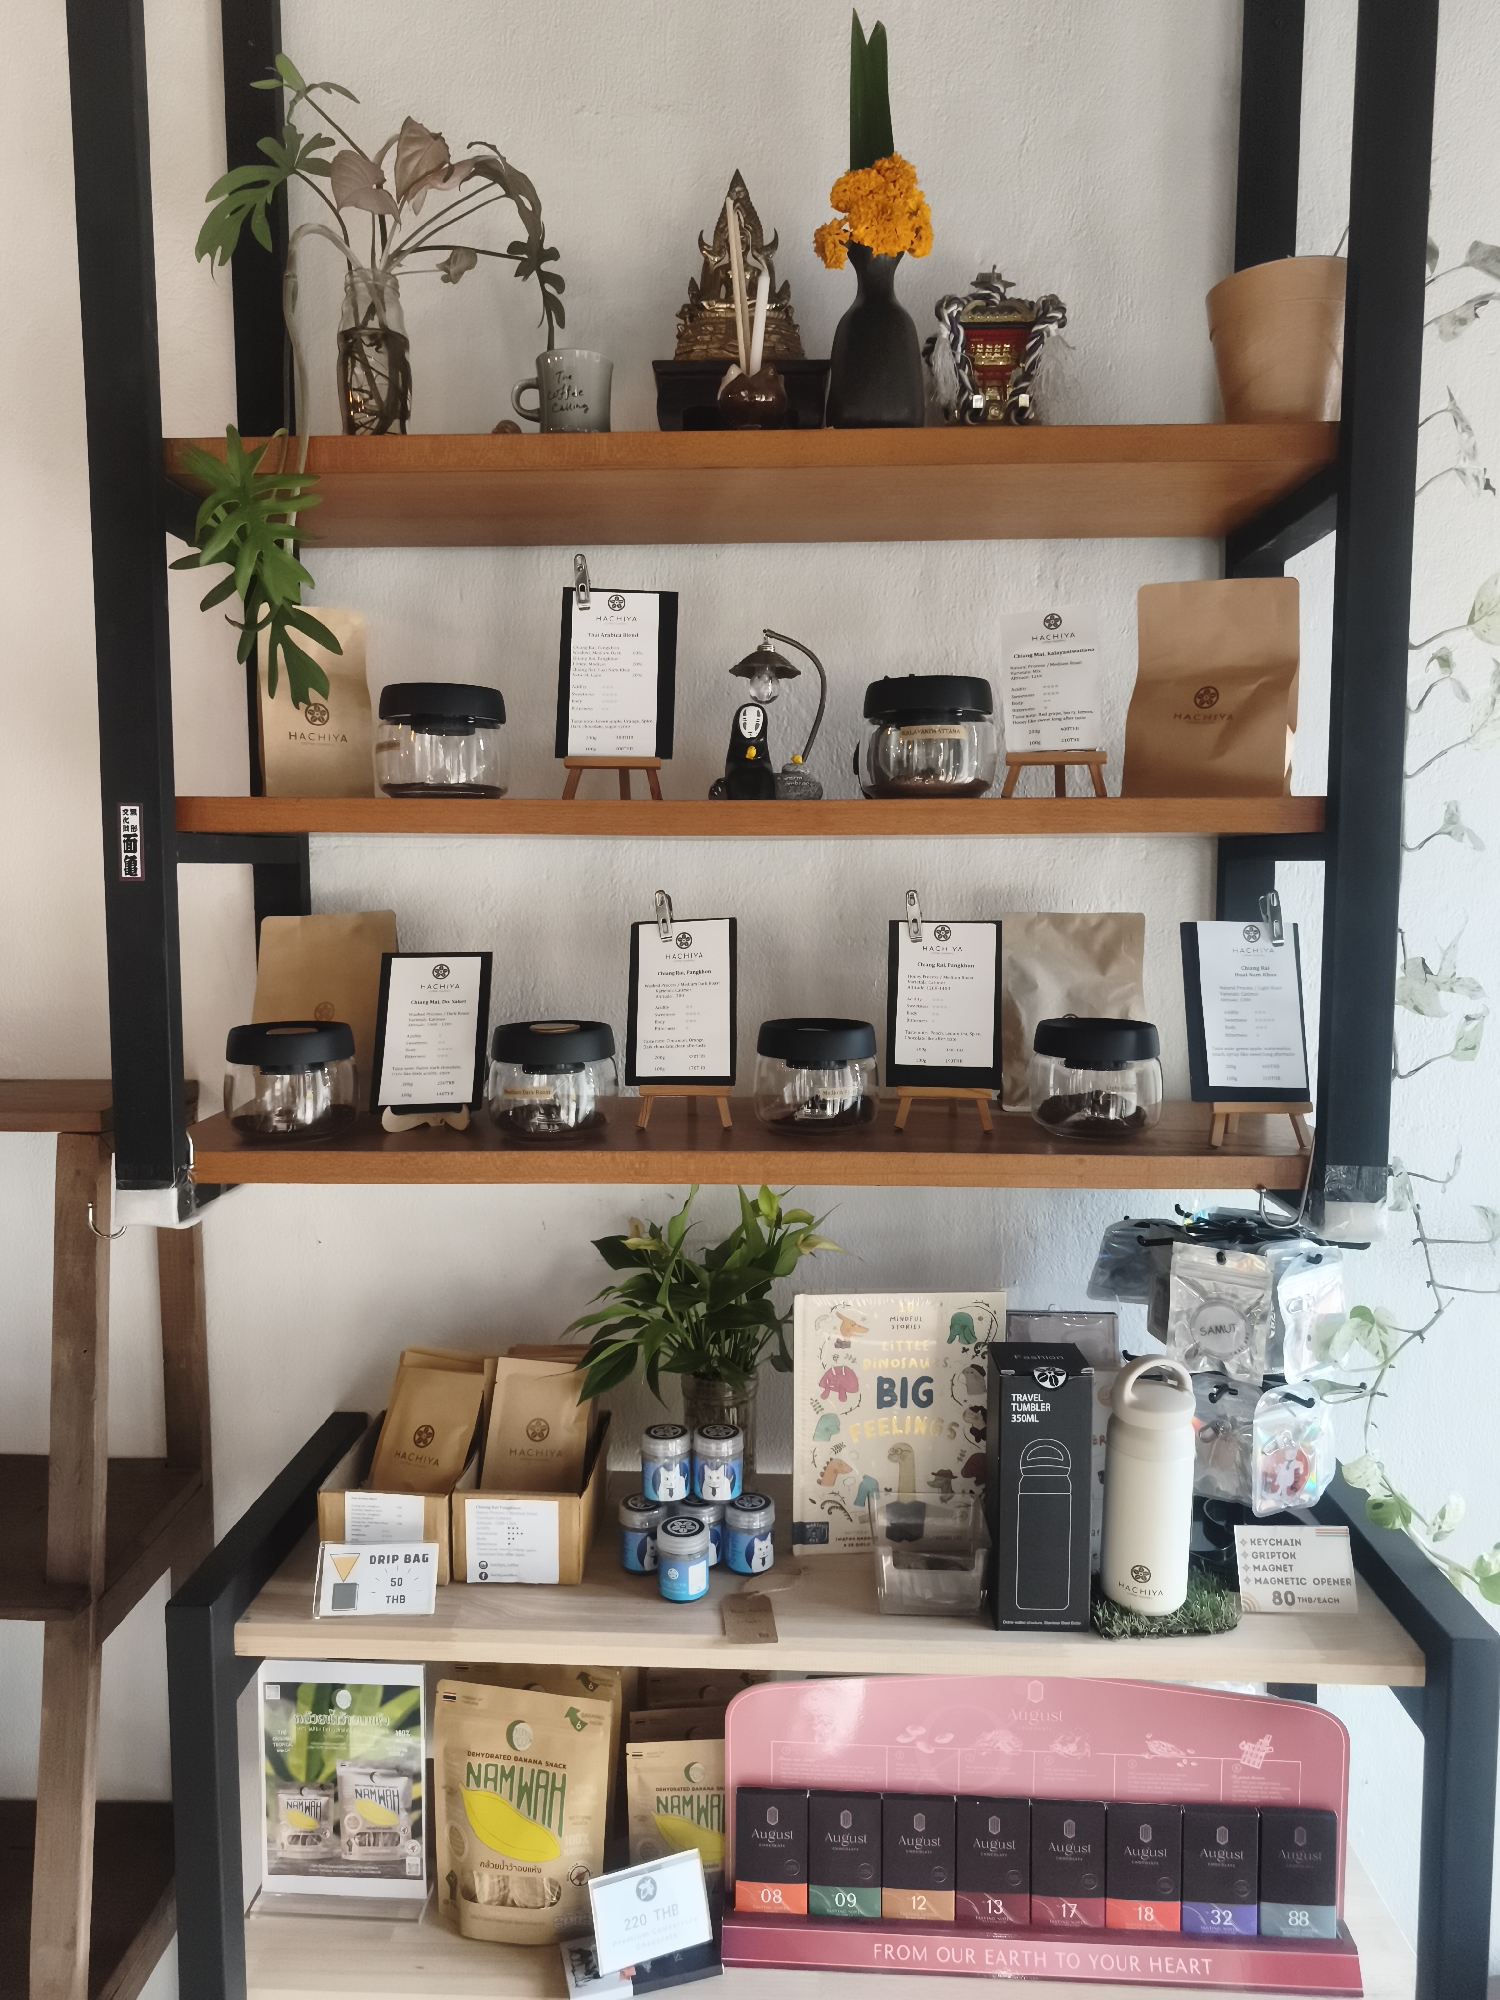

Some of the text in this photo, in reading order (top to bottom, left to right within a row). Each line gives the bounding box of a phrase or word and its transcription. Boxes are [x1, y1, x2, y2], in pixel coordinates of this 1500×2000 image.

[555, 371, 572, 383] The
[552, 402, 589, 414] Calling
[1032, 632, 1075, 641] HACHIYA
[1173, 713, 1233, 721] HACHIYA
[289, 732, 348, 743] HACHIYA
[876, 1375, 934, 1410] BIG
[1011, 1403, 1050, 1411] TUMBLER
[1011, 1414, 1039, 1422] 350ML
[850, 1415, 960, 1444] FEELINGS
[394, 1450, 440, 1467] HACHIYA
[509, 1448, 563, 1458] HACHIYA
[370, 1554, 429, 1564] DRIP BAG
[1253, 1564, 1293, 1572] MAGNET
[391, 1578, 402, 1586] 50
[1118, 1581, 1163, 1596] HACHIYA
[1254, 1577, 1352, 1586] MAGNETIC OPENER
[386, 1595, 406, 1603] THB
[1272, 1590, 1295, 1606] 80
[1007, 1708, 1064, 1726] August
[467, 1751, 566, 1769] DEHYDRATED BANANA SNACK
[355, 1788, 400, 1815] NAMWAH
[466, 1761, 566, 1838] NAMWAH
[286, 1800, 322, 1818] NAMWAH
[564, 1833, 590, 1847] 100%
[752, 1828, 793, 1842] August
[825, 1832, 867, 1846] August
[899, 1836, 940, 1849] August
[973, 1838, 1016, 1852] August
[1049, 1842, 1092, 1855] August
[1124, 1846, 1168, 1860] August
[1200, 1849, 1244, 1862] August
[1278, 1850, 1322, 1863] August
[480, 1860, 542, 1874] กล้วยน้ำว้าอบแห้ง
[760, 1888, 782, 1904] 08
[835, 1892, 857, 1907] 09
[911, 1895, 927, 1910] 12
[987, 1899, 1004, 1914] 13
[1061, 1903, 1077, 1918] 17
[624, 1904, 679, 1931] 220 THB
[1137, 1907, 1154, 1921] 18
[1210, 1910, 1233, 1926] 32
[1288, 1910, 1309, 1927] 88
[612, 1916, 698, 1947] Premium Couverture
[636, 1932, 678, 1950] Chocolate
[873, 1943, 1213, 1976] FROM OUR EARTH TO YOUR HEART
